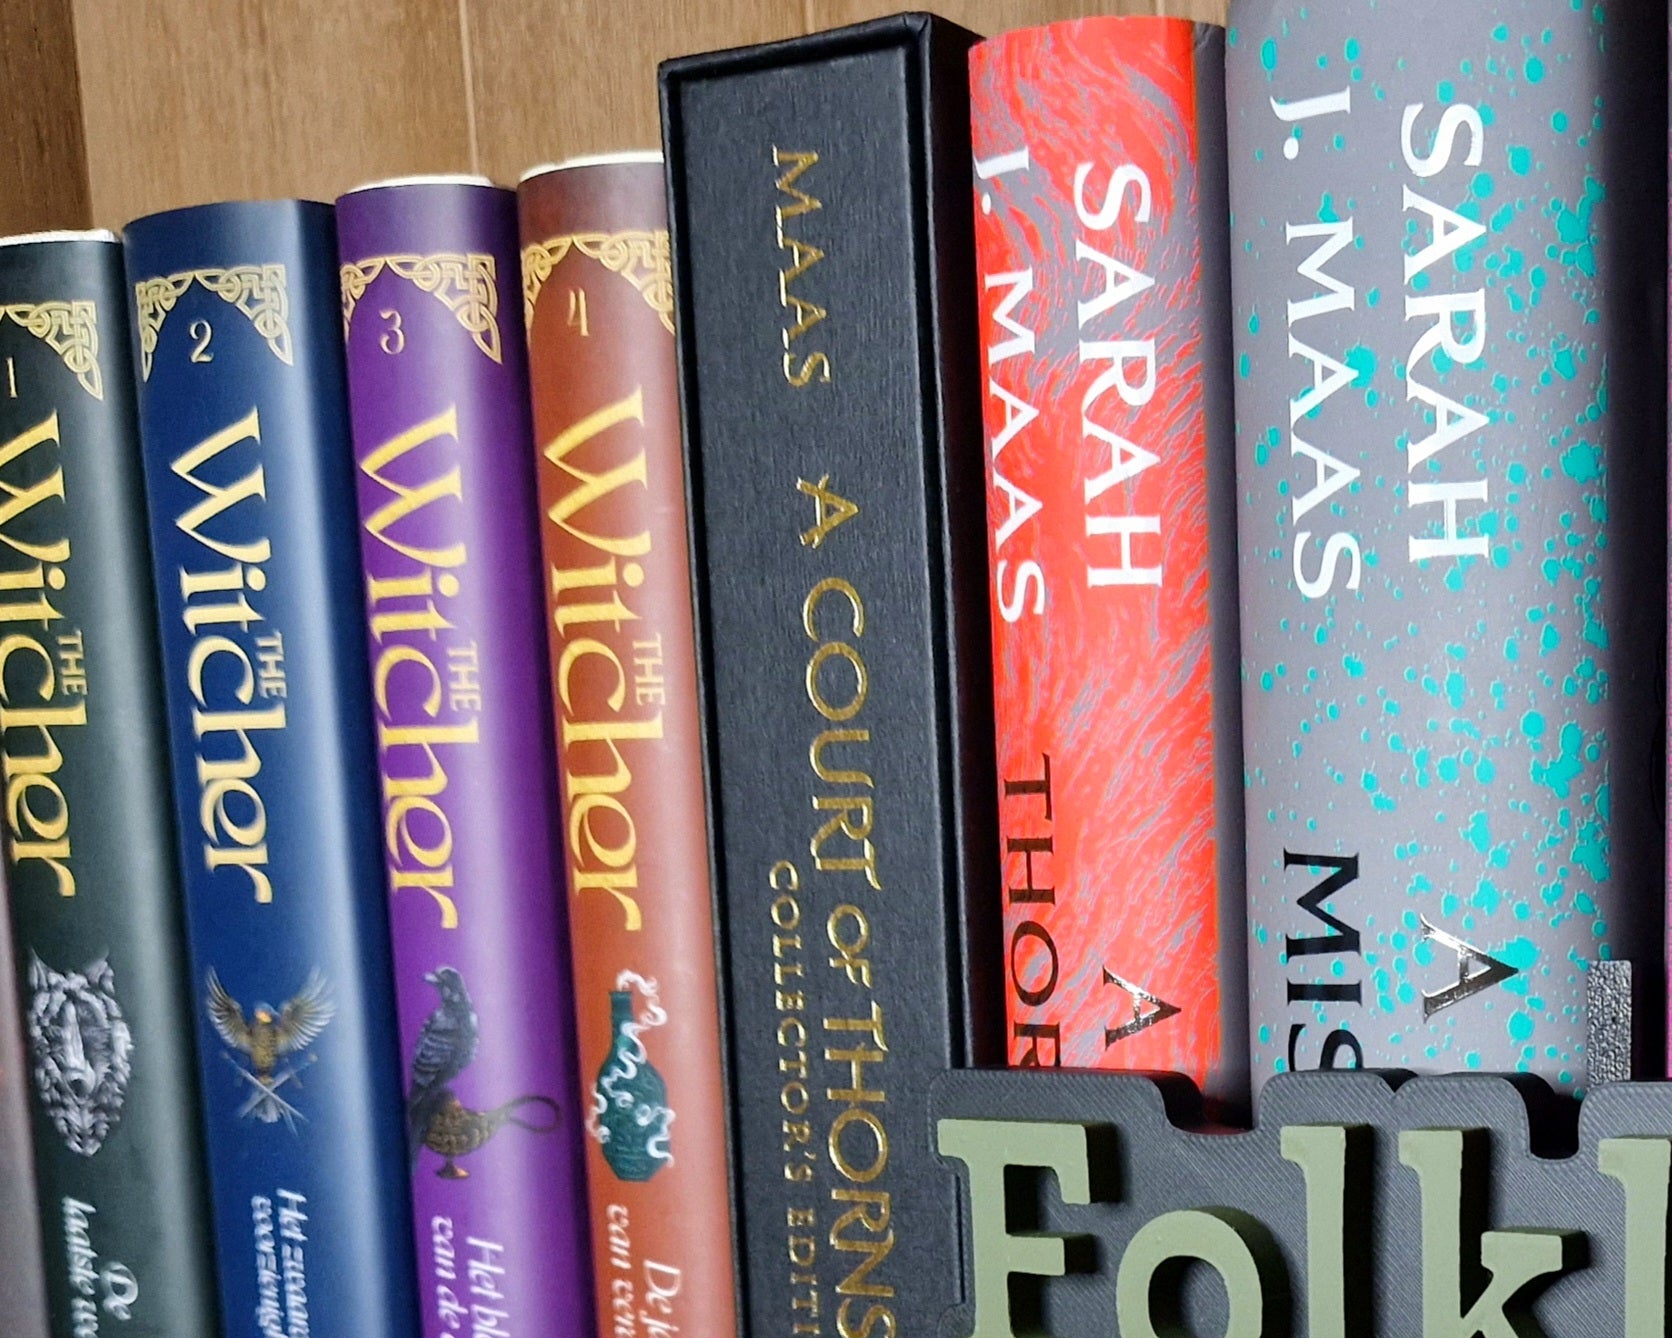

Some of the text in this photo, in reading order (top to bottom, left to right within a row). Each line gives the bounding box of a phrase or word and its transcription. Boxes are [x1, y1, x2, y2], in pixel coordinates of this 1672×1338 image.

[772, 146, 832, 387] MAAS
[189, 318, 214, 364] 2
[379, 308, 406, 355] 3
[565, 286, 589, 337] 4
[1270, 86, 1361, 599] J. MAAS
[1400, 102, 1489, 562] SARAH
[974, 147, 1045, 624] J. MAAS
[1074, 161, 1163, 589] SARAH
[796, 475, 860, 549] A
[0, 410, 88, 899] Witcher
[54, 630, 88, 698] THE
[170, 405, 289, 905] Witcher
[254, 632, 288, 698] THE
[357, 402, 480, 931] Witcher
[445, 640, 482, 713] THE
[542, 386, 664, 933] Witcher
[631, 632, 666, 707] THE
[803, 578, 881, 891] COURT
[827, 905, 872, 990] OF
[1003, 752, 1061, 1067] THOR
[1283, 847, 1363, 1072] MIS
[1420, 913, 1519, 1024] A
[767, 860, 813, 1185] COLLECTOR'S
[1102, 965, 1182, 1052] A
[431, 1216, 463, 1278] van
[466, 1236, 505, 1297] Het
[607, 1204, 633, 1268] van
[436, 1284, 467, 1329] de
[642, 1259, 682, 1312] De
